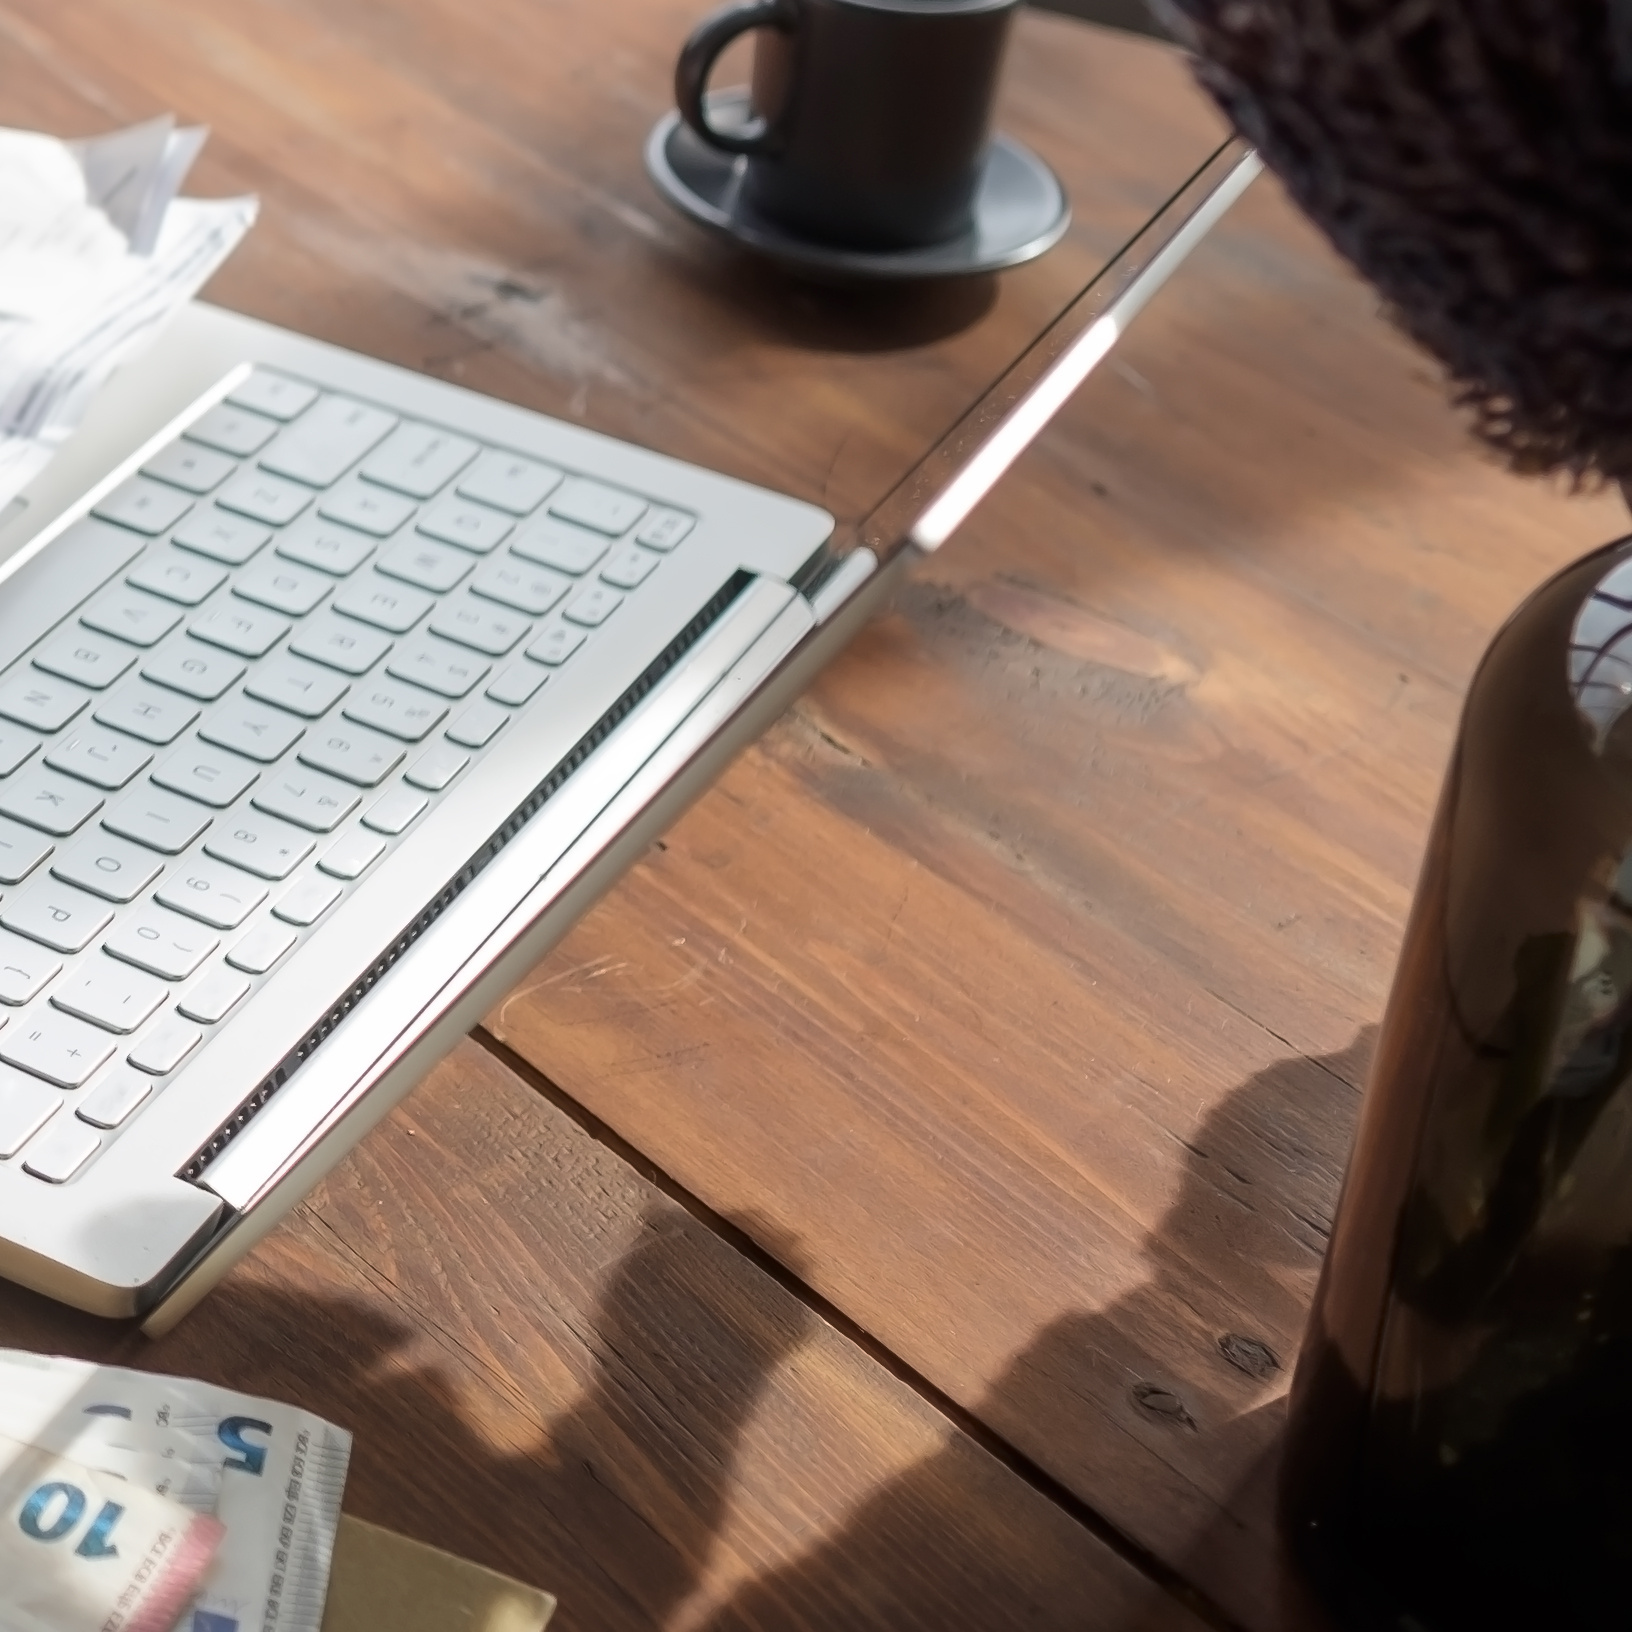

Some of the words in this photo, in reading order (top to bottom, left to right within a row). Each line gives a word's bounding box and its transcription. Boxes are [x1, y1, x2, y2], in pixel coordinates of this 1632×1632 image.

[72, 648, 101, 663] B
[180, 658, 207, 674] G
[288, 677, 314, 693] T
[23, 690, 51, 707] N
[132, 701, 162, 720] H
[242, 720, 269, 736] Y
[192, 765, 221, 782] U
[35, 790, 65, 807] K
[283, 783, 306, 798] 7
[233, 829, 257, 843] 8
[94, 856, 121, 872] O
[186, 876, 210, 892] 9
[47, 905, 71, 922] P
[137, 926, 160, 941] 0
[217, 1415, 273, 1477] 5
[19, 1482, 126, 1560] 10
